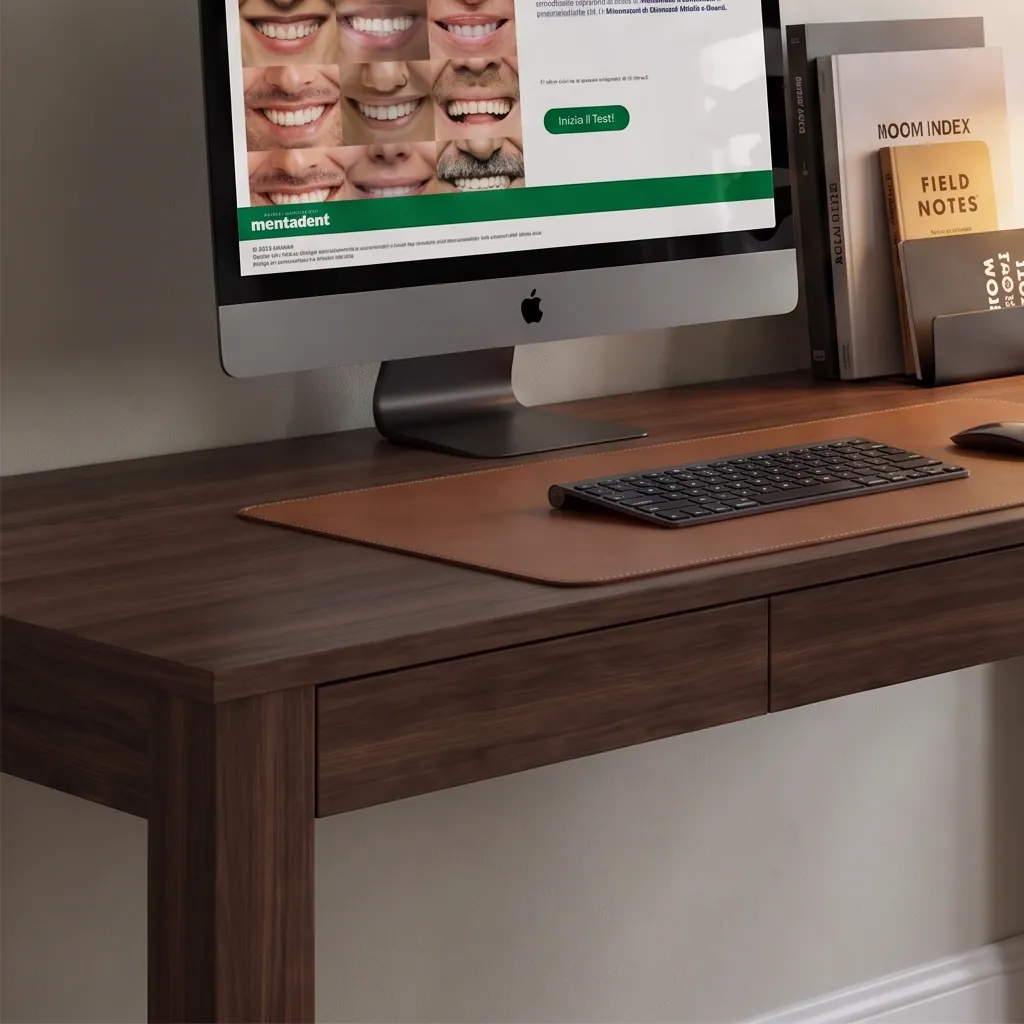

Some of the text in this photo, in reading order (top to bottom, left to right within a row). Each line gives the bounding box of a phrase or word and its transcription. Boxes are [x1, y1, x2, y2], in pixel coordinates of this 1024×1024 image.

[558, 115, 584, 126] Inizia
[592, 113, 615, 124] Test!
[877, 118, 971, 140] MOOM INDEX
[921, 173, 970, 194] FIELD
[918, 196, 977, 217] NOTES
[251, 212, 331, 232] mentadent
